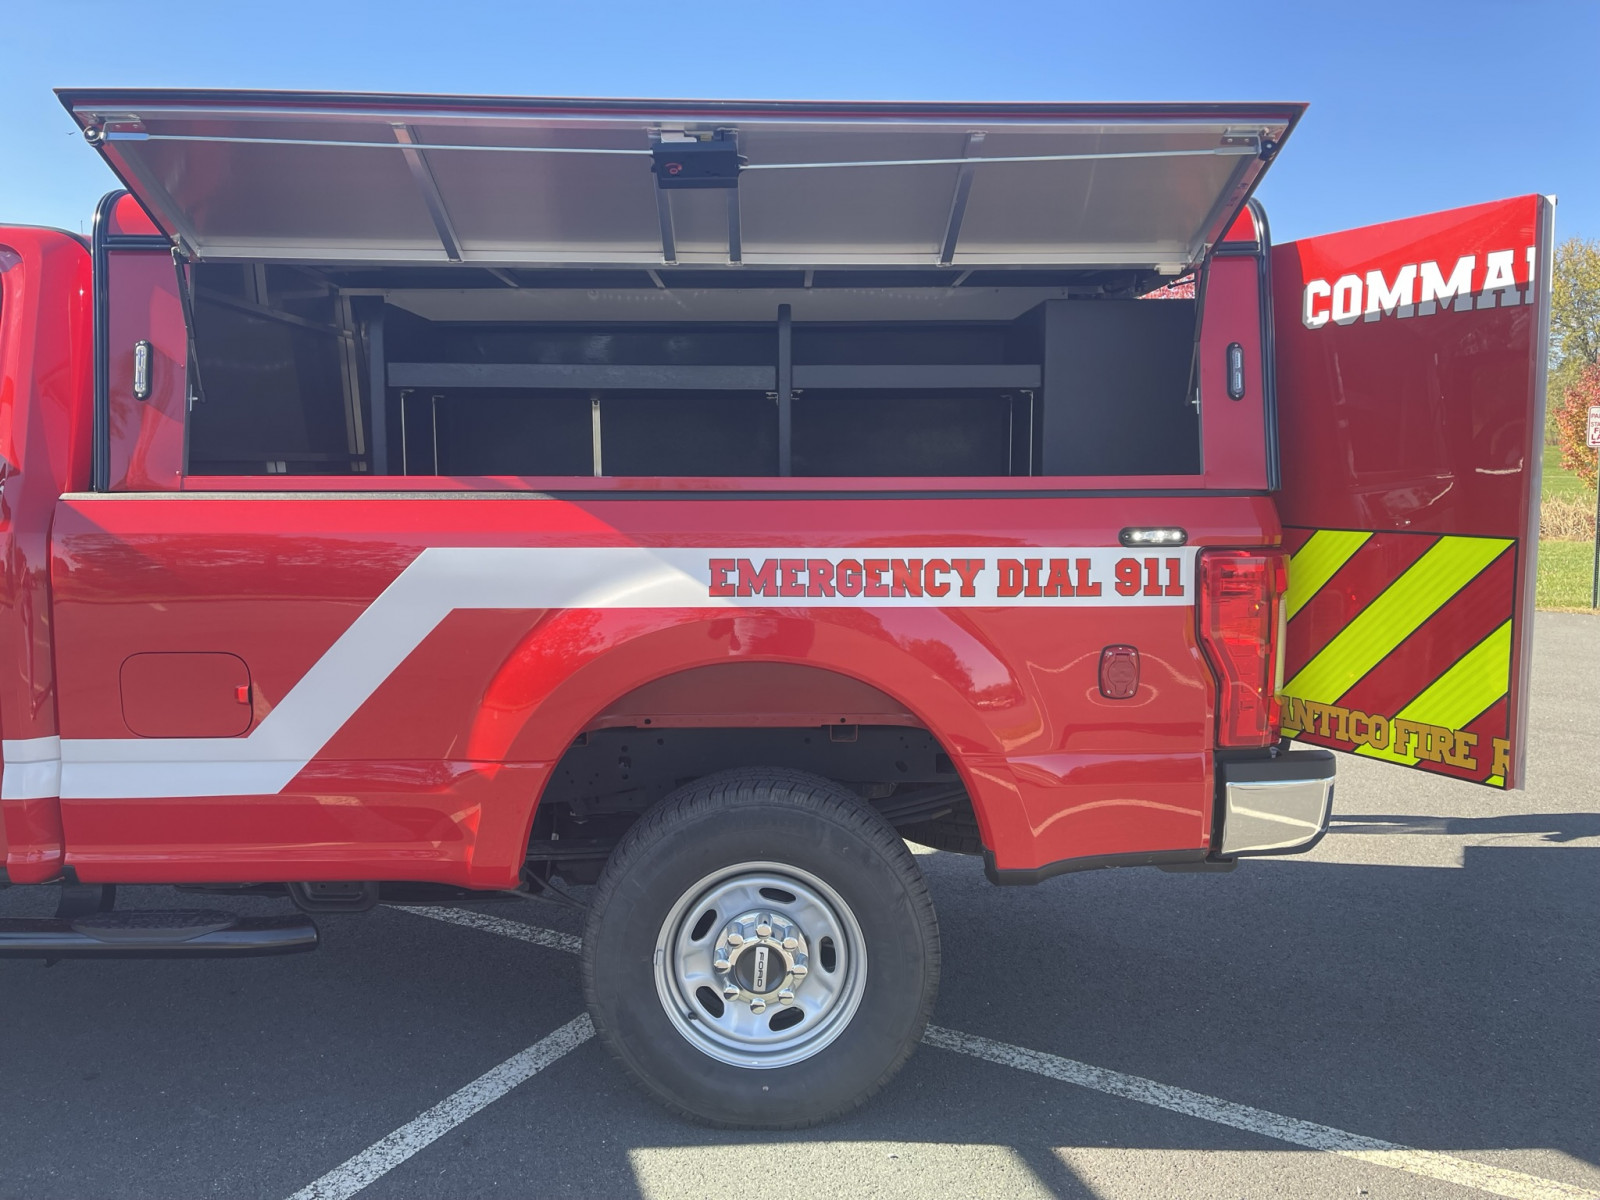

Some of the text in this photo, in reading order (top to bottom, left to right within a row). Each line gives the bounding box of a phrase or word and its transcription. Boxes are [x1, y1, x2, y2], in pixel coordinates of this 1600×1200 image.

[1302, 246, 1536, 330] COMMA
[708, 557, 1186, 598] EMERGENCY DIAL 911
[1393, 717, 1478, 771] FIRE
[757, 952, 765, 987] FORD
